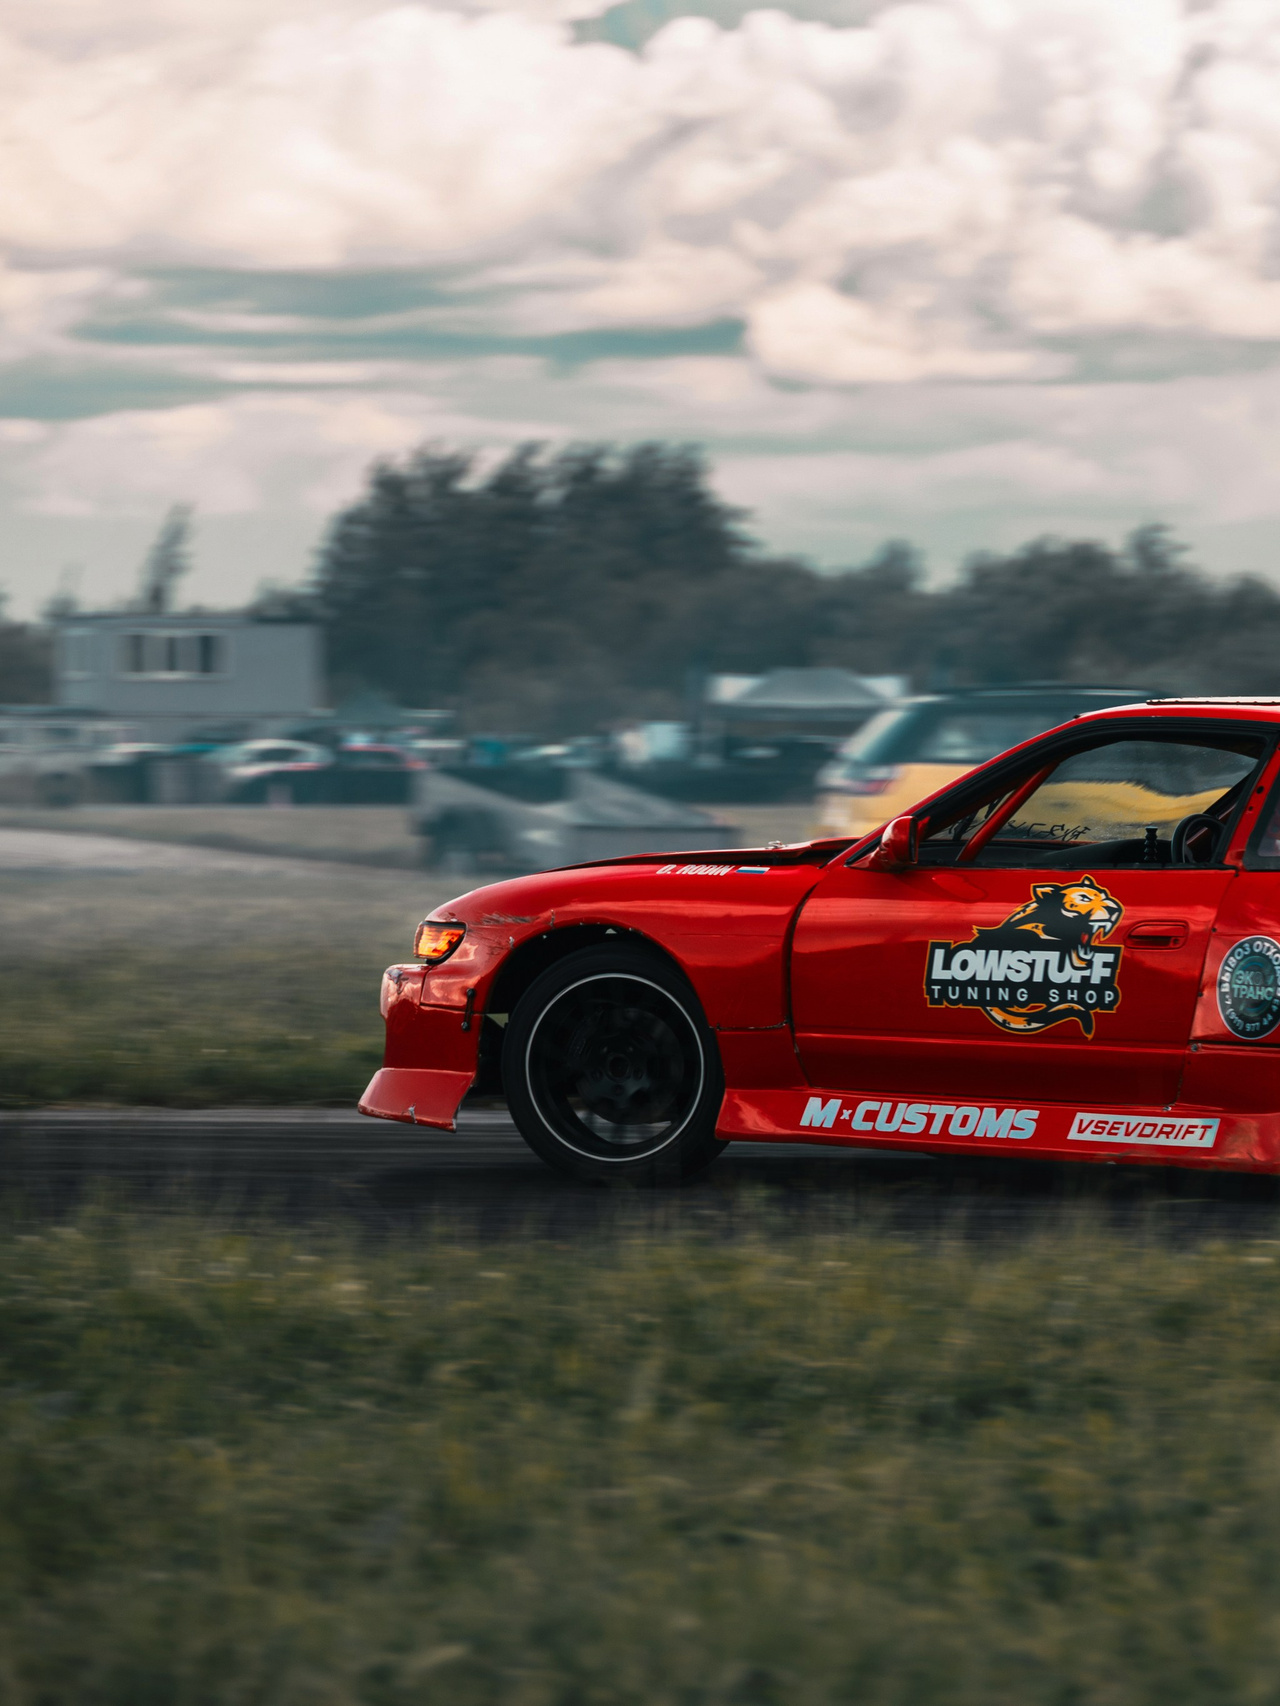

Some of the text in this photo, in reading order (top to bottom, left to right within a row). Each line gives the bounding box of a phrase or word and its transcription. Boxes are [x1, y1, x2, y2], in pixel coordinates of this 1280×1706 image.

[931, 949, 1115, 984] LOWSTUFF
[1221, 943, 1251, 992] ВЫВОЗ
[931, 986, 1115, 1004] TUNING SHOP
[1232, 984, 1274, 1000] ТРАНС
[1077, 1118, 1213, 1142] VSEVDRIFT
